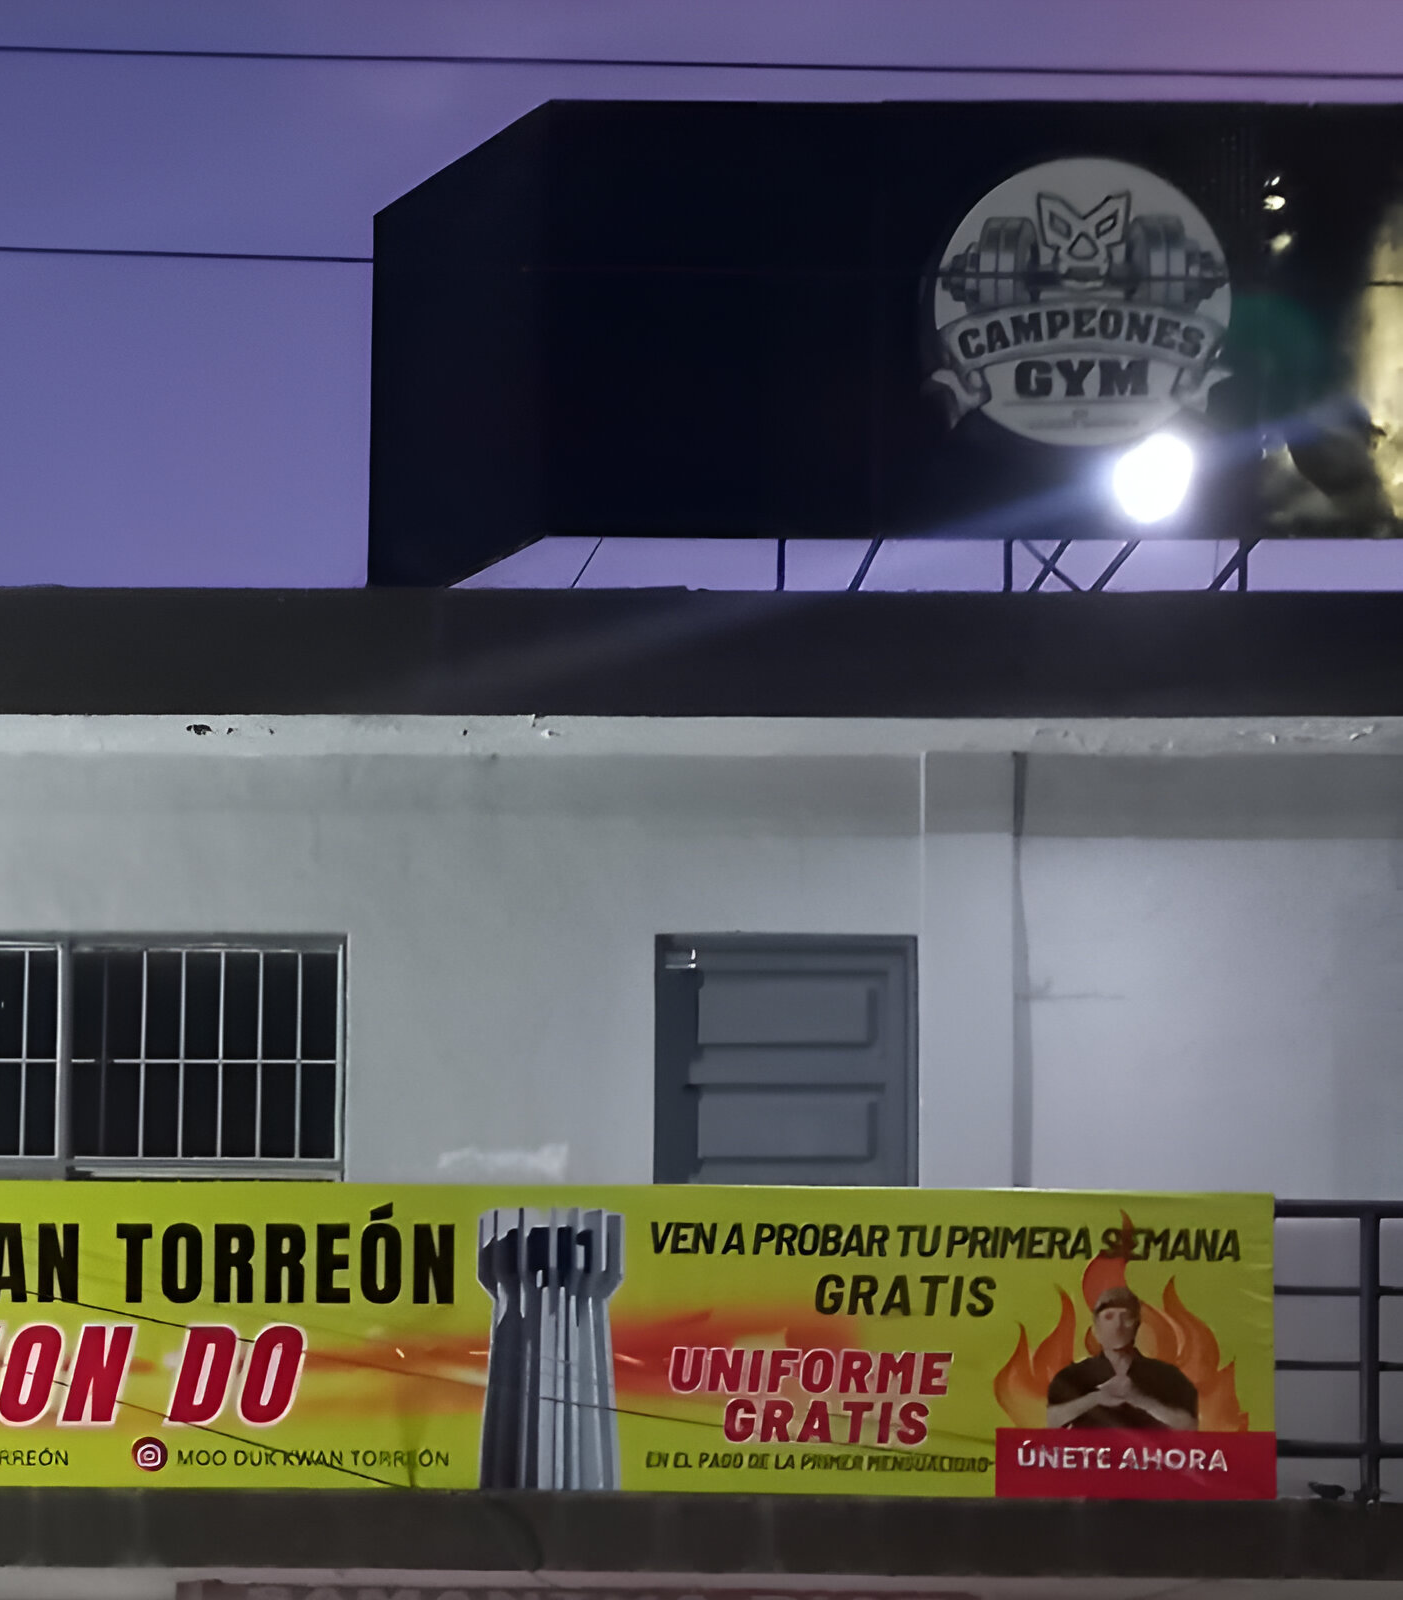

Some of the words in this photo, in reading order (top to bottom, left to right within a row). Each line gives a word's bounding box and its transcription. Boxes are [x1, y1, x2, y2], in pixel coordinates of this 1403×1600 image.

[958, 307, 1206, 359] CAMPEONES
[1015, 359, 1149, 398] GYM
[116, 1202, 455, 1305] TORREÓN
[650, 1221, 718, 1254] VEN
[720, 1222, 746, 1255] A
[752, 1222, 890, 1257] PROBAR
[896, 1224, 942, 1258] TU
[946, 1225, 1093, 1260] PRIMERA
[1100, 1227, 1241, 1262] SEMANA
[815, 1273, 997, 1317] GRATIS
[164, 1322, 308, 1427] DO
[669, 1347, 954, 1395] UNIFORME
[723, 1398, 930, 1446] GRATIS
[177, 1450, 228, 1467] MOO
[1017, 1440, 1111, 1469] ÚNETE
[1119, 1447, 1228, 1472] AHORA
